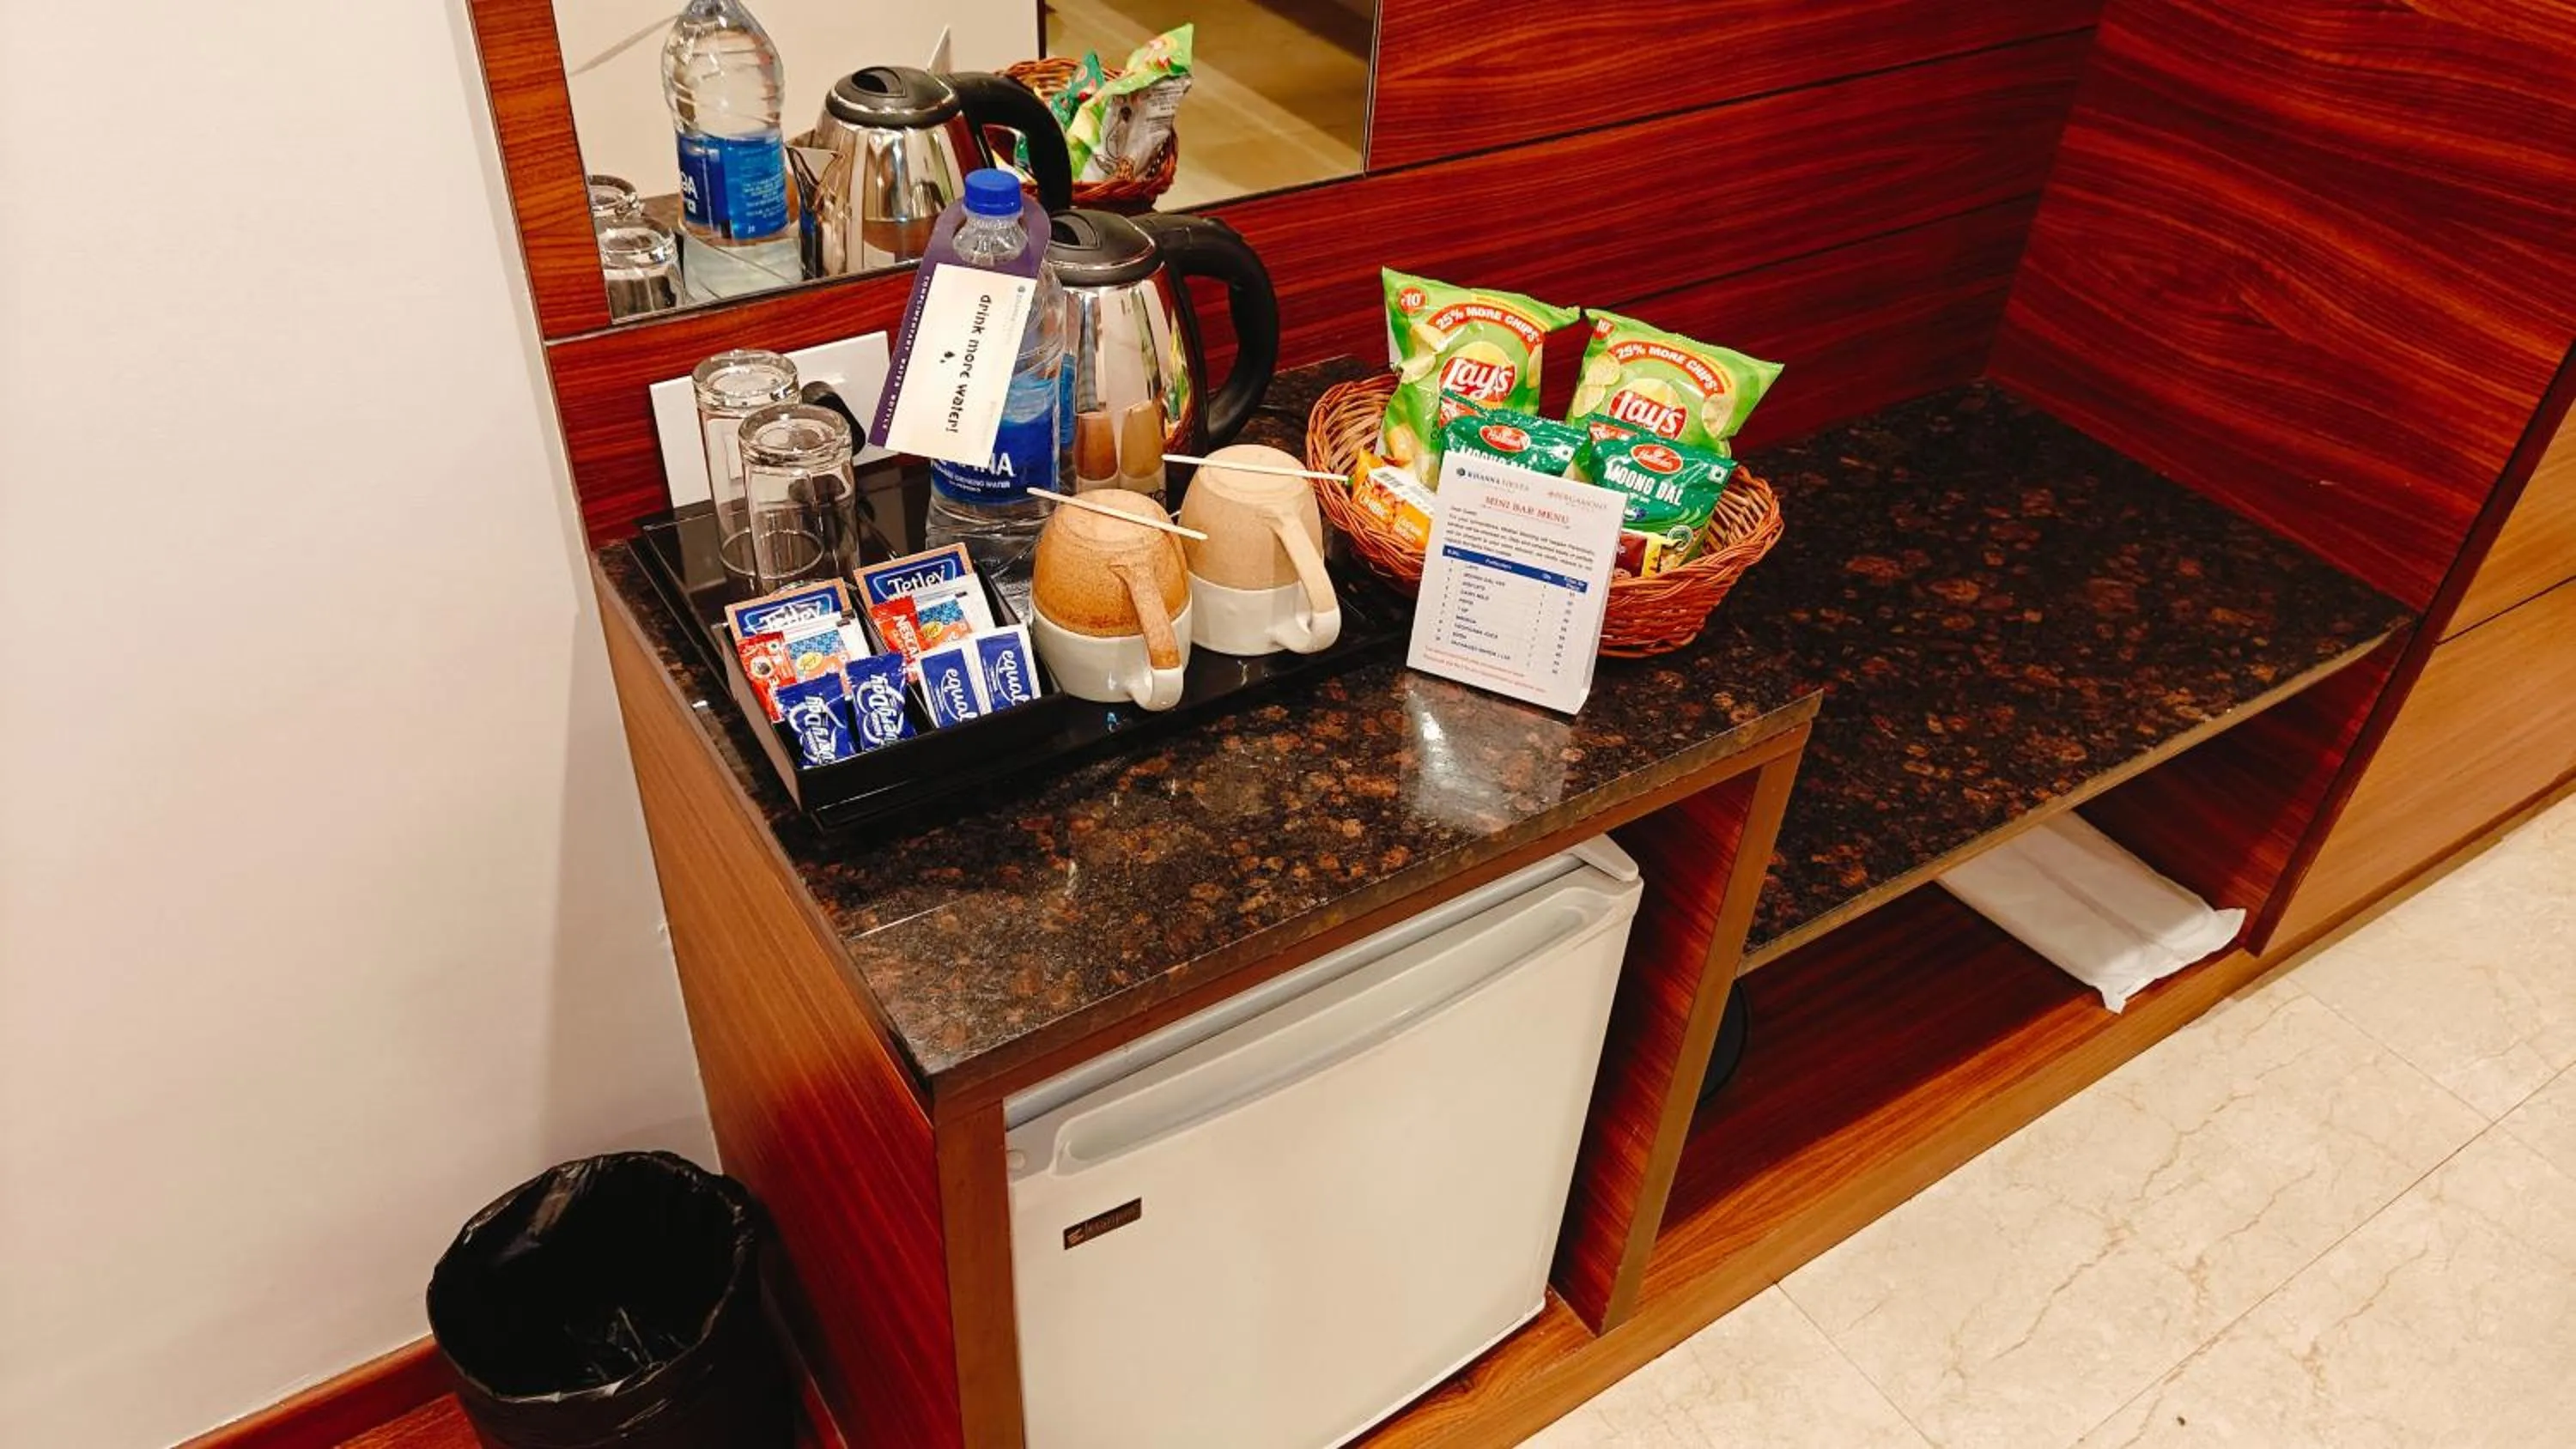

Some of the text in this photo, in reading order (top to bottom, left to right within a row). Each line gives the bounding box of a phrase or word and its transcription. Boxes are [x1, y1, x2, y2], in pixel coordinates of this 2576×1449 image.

[1436, 310, 1464, 330] 25%
[1467, 306, 1503, 319] MORE
[945, 294, 992, 433] drink more water!
[1616, 343, 1645, 359] 25%
[1649, 346, 1686, 364] MORE
[1604, 464, 1656, 495] MOONG
[1656, 481, 1685, 507] DAL
[1485, 495, 1571, 524] MINI BAR MENU
[888, 565, 945, 594] Tetley
[893, 614, 919, 655] NESCA
[943, 668, 978, 721] equal
[999, 651, 1030, 706] equal
